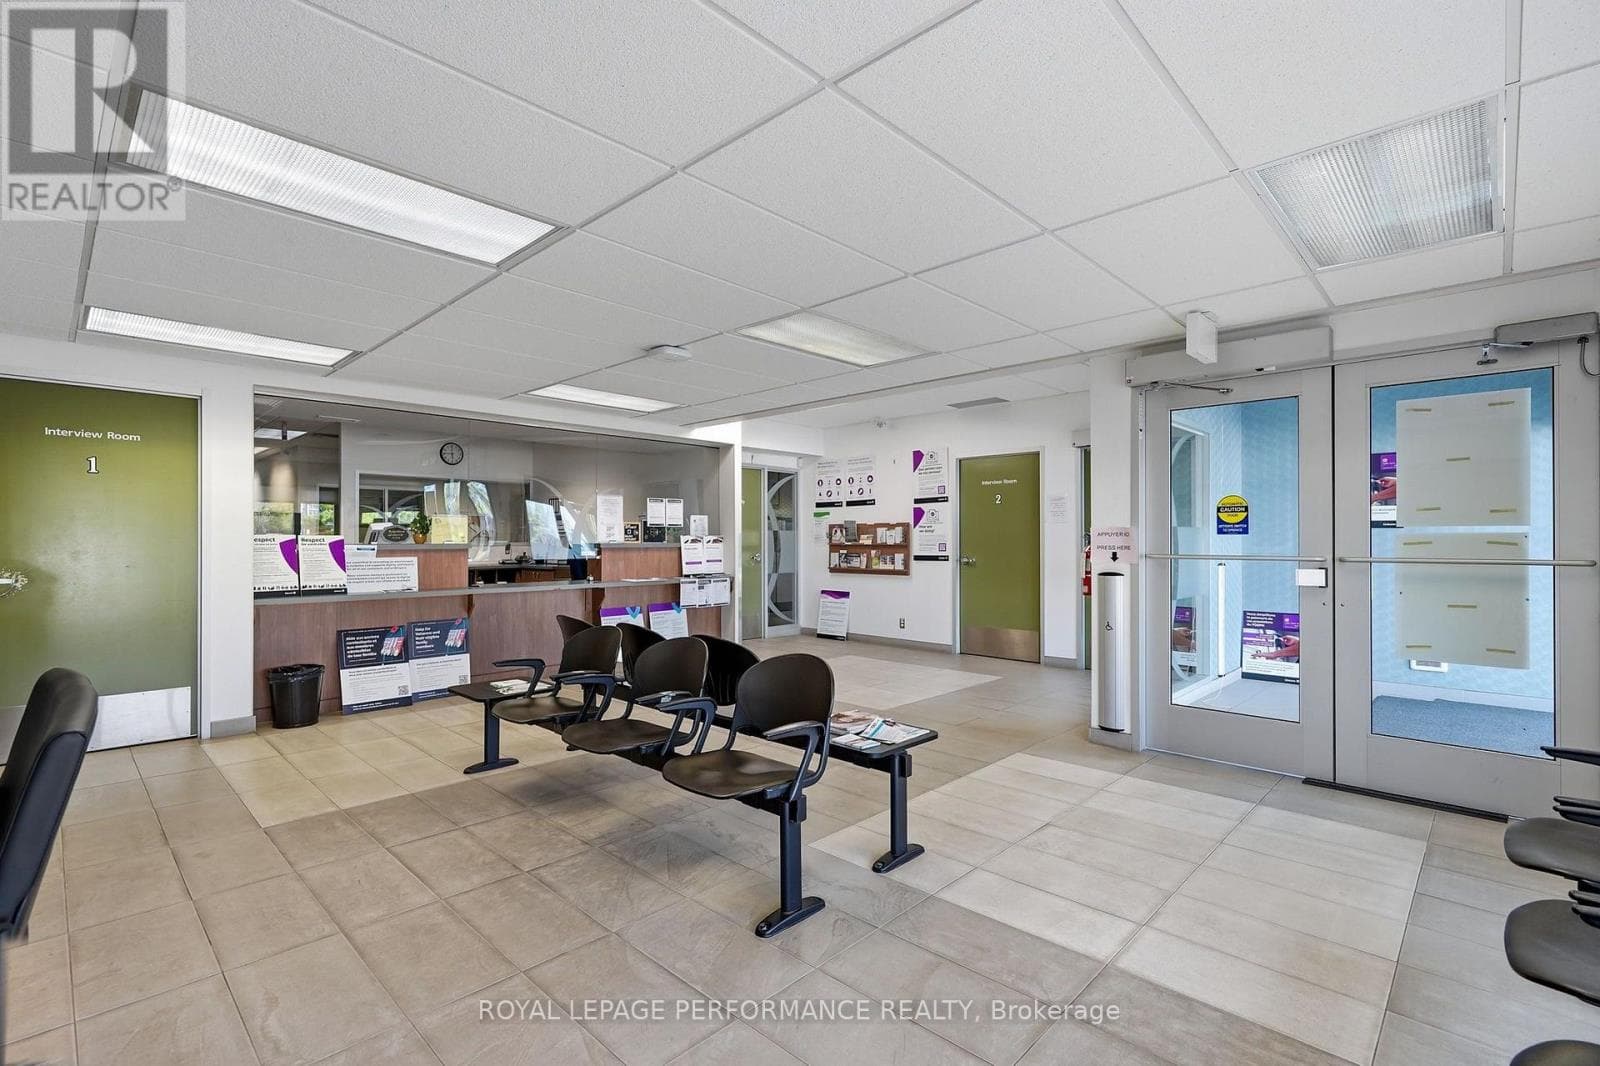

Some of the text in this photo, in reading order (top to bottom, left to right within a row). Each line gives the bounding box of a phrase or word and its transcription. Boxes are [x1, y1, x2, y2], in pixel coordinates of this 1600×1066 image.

[44, 426, 141, 441] Interview Room
[86, 455, 100, 474] 1
[995, 494, 1002, 504] 2
